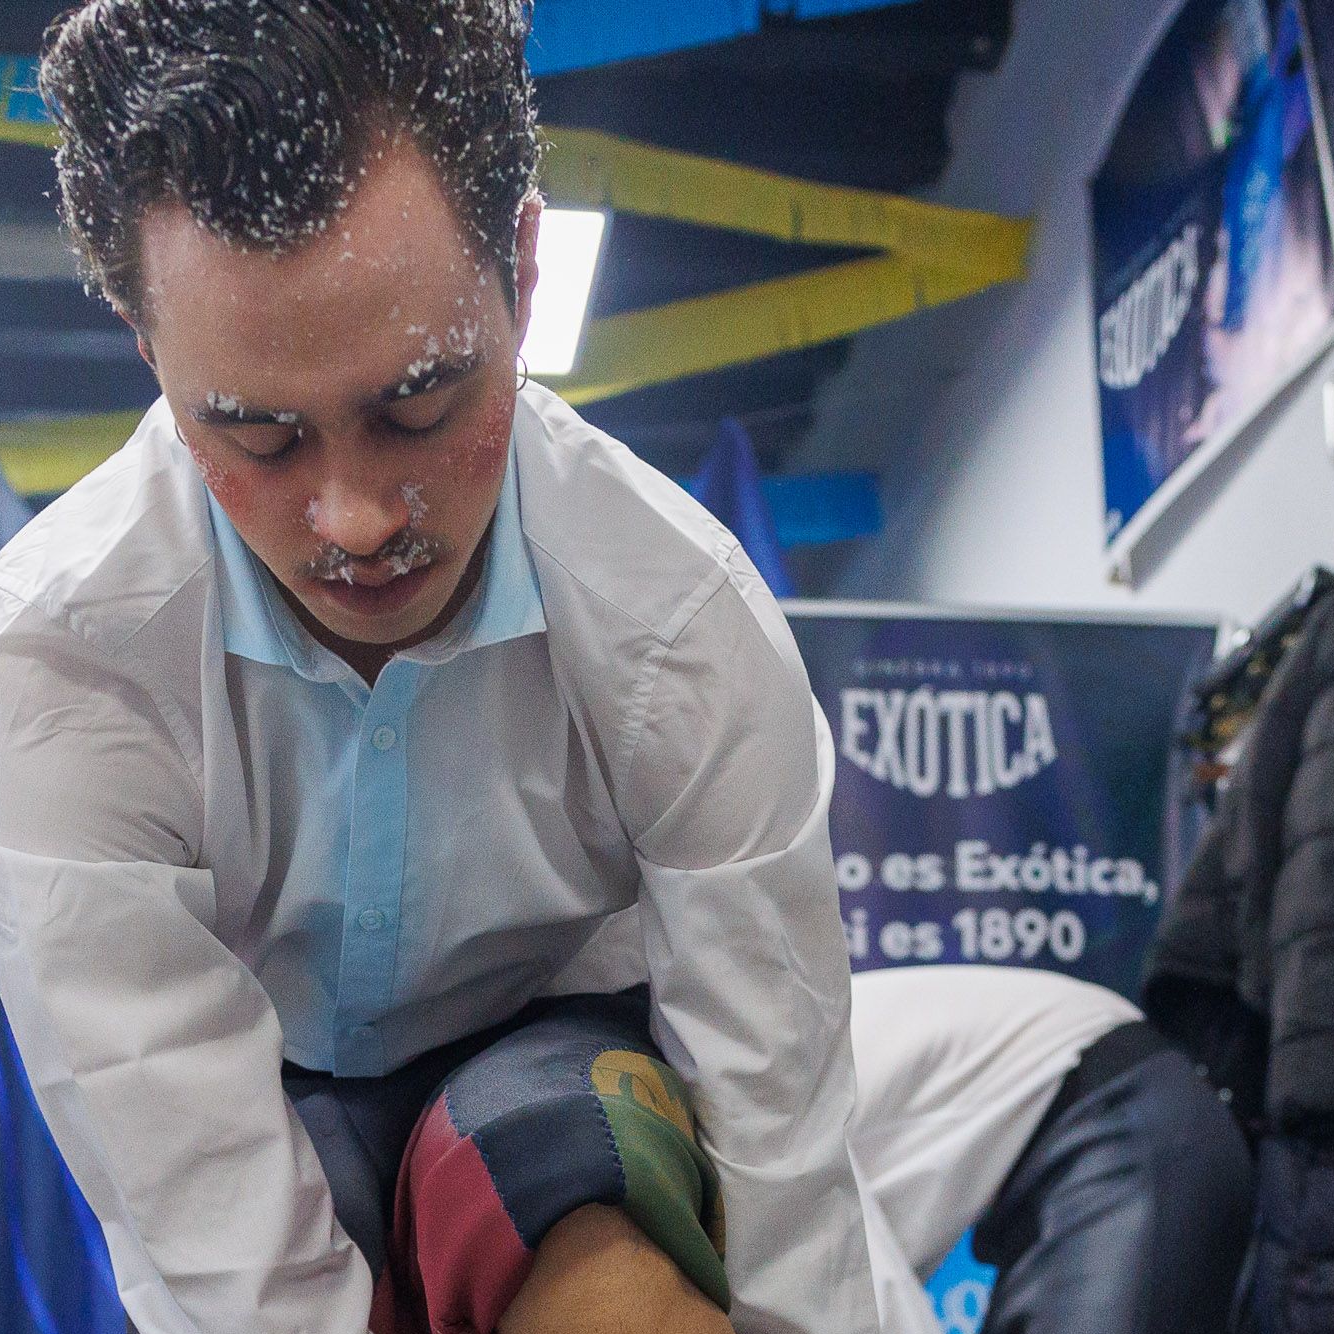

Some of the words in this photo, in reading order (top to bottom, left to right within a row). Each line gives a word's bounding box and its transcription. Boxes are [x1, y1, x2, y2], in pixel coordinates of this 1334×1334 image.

[840, 684, 1058, 799] EXÓTICA
[834, 852, 872, 892] o
[880, 852, 946, 892] es
[953, 840, 1159, 907] Exótica,
[878, 921, 945, 960] es
[951, 906, 1087, 963] 1890
